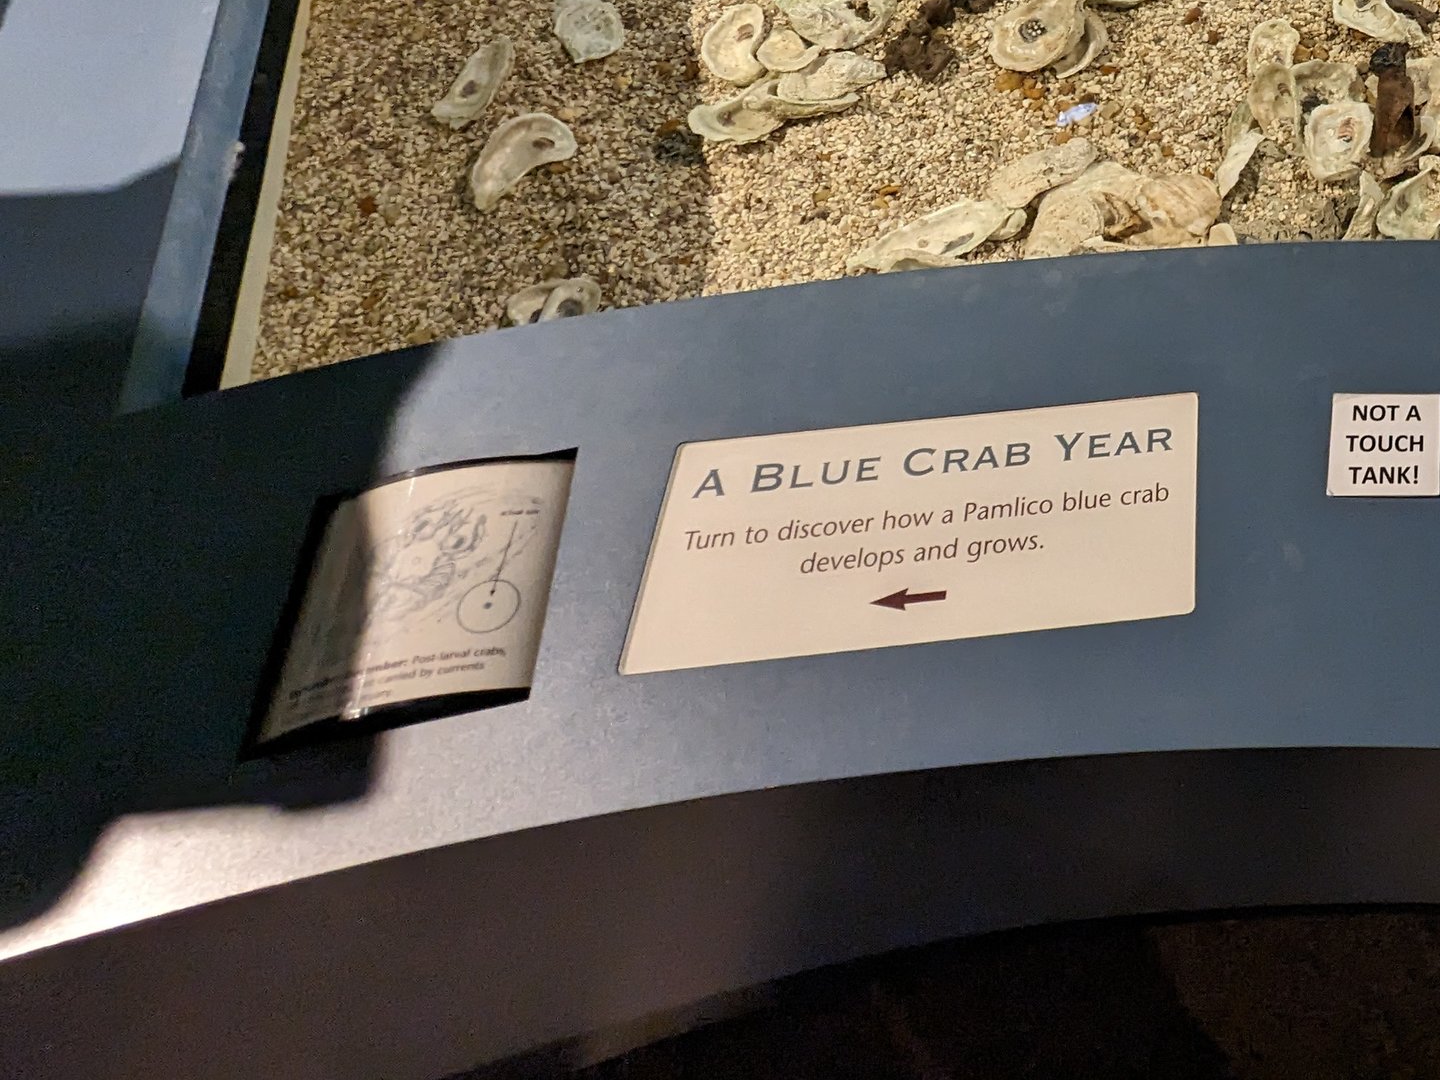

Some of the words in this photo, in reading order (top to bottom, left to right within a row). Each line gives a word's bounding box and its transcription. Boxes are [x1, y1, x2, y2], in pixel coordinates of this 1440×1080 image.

[1352, 404, 1400, 422] NOT
[1405, 404, 1422, 422] A
[1345, 434, 1424, 452] TOUCH
[691, 468, 726, 500] A
[751, 456, 882, 493] BLUE
[903, 441, 1031, 477] CRAB
[1054, 427, 1173, 461] YEAR
[1348, 465, 1419, 485] TANK!
[684, 531, 736, 551] Turn
[745, 526, 769, 544] to
[777, 519, 875, 541] discover
[882, 510, 934, 530] how
[941, 509, 954, 524] a
[963, 496, 1053, 522] Pamlico
[1062, 490, 1112, 512] blue
[1120, 482, 1169, 505] crab
[800, 547, 905, 574] develops
[913, 537, 958, 562] and
[967, 534, 1044, 563] grows.
